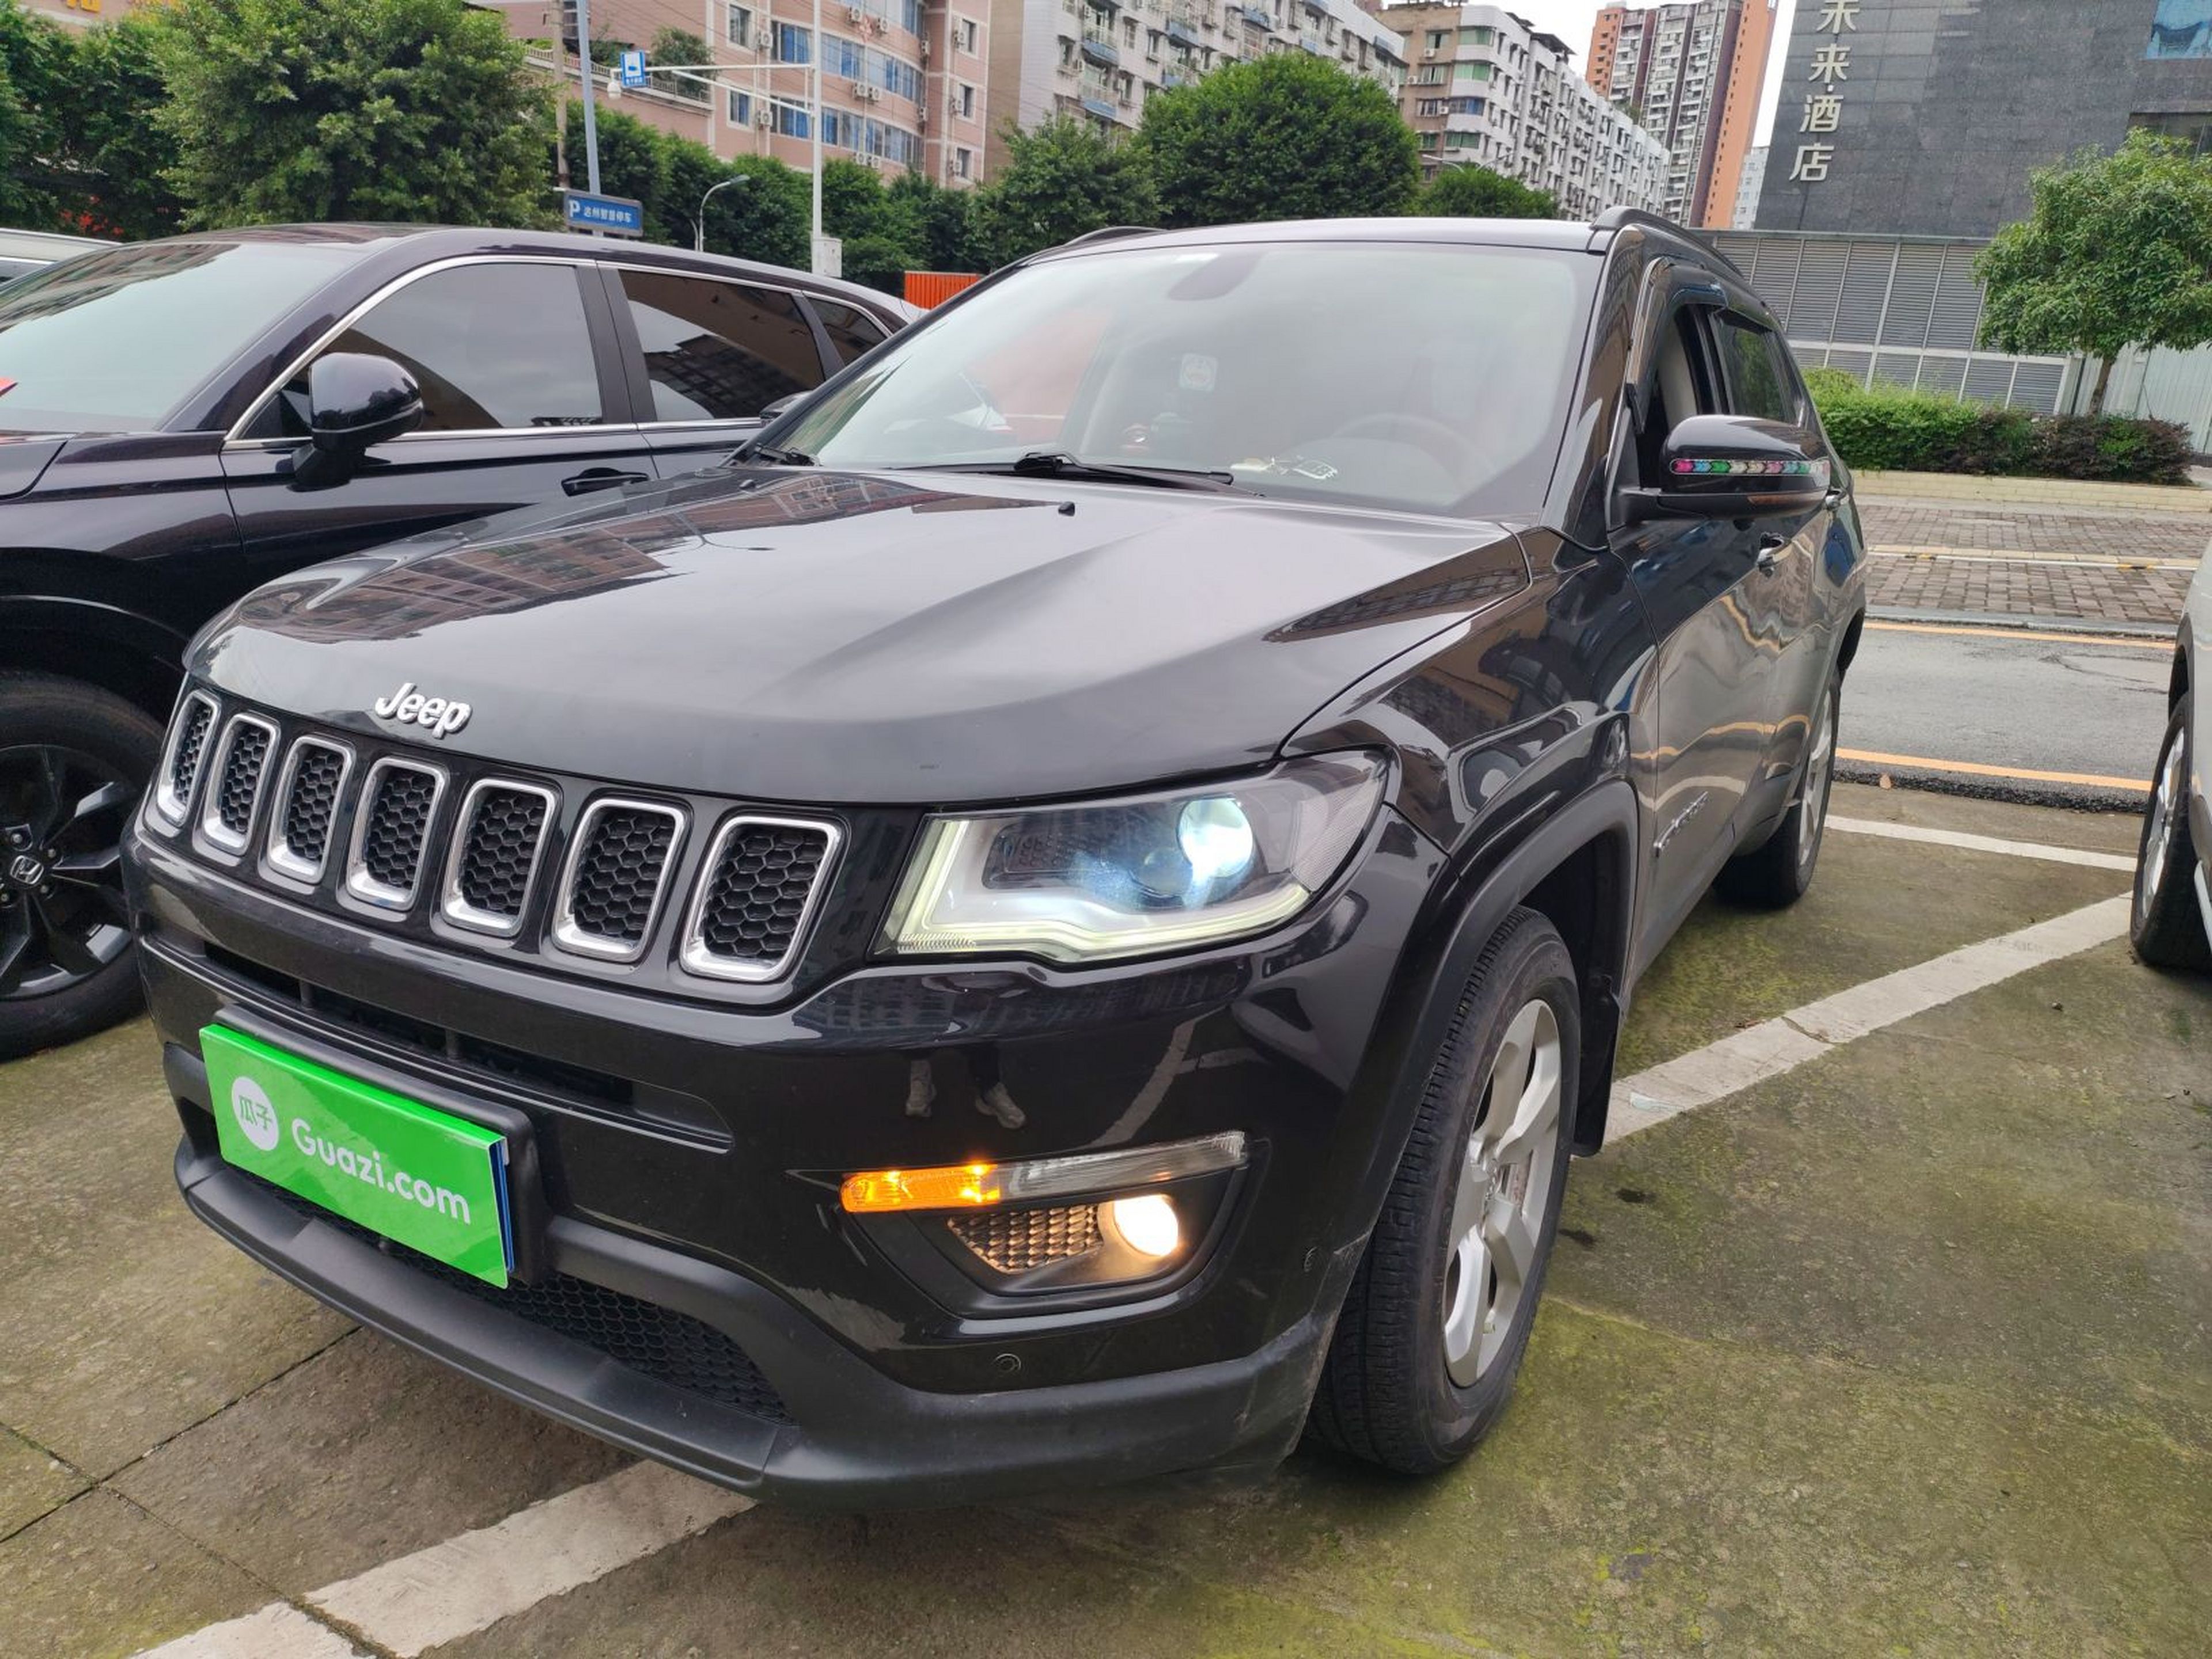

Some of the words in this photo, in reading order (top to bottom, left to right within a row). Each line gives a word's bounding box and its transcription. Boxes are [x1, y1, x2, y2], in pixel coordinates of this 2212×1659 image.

[569, 199, 581, 218] P
[374, 682, 473, 740] Jeep
[238, 1094, 273, 1131] 瓜子
[291, 1118, 471, 1225] Guazi.com
